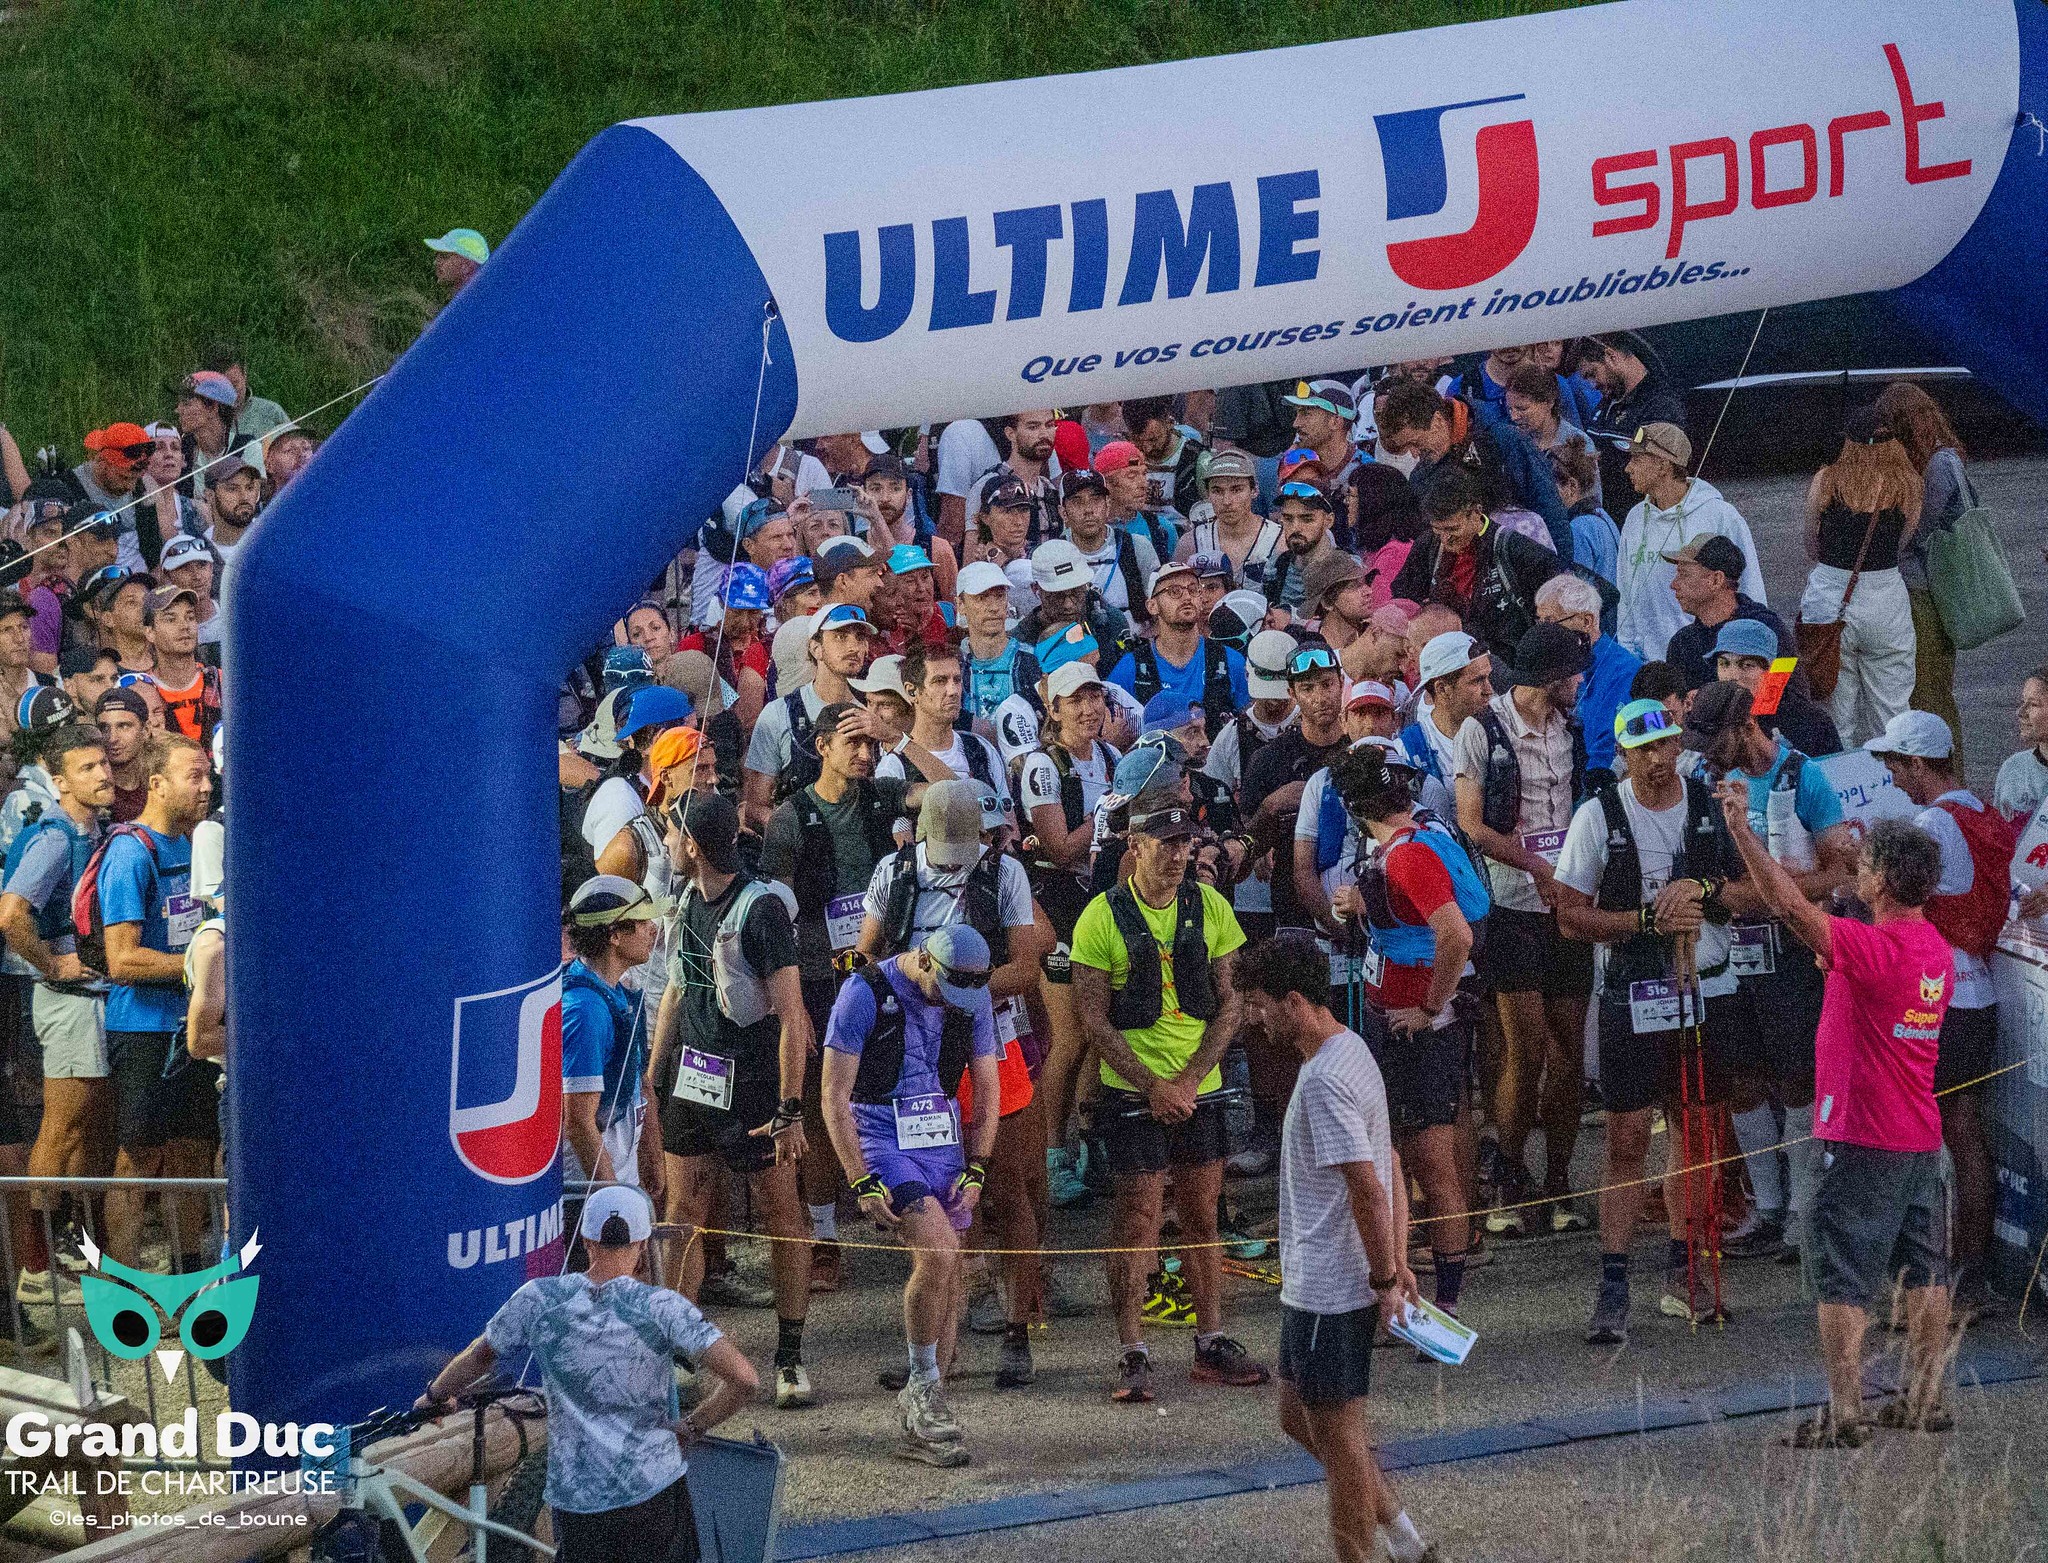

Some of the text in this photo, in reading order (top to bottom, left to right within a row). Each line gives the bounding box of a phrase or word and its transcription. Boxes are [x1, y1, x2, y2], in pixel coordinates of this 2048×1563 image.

[823, 169, 1321, 344] ULTIME
[1591, 43, 1972, 259] sport
[1021, 257, 1752, 384] Que vos courses soient inoubliables...
[1537, 835, 1560, 848] 500
[840, 900, 861, 912] 414
[1903, 1008, 1939, 1028] Super
[911, 1099, 934, 1112] 473
[919, 1114, 942, 1122] ROMAIN
